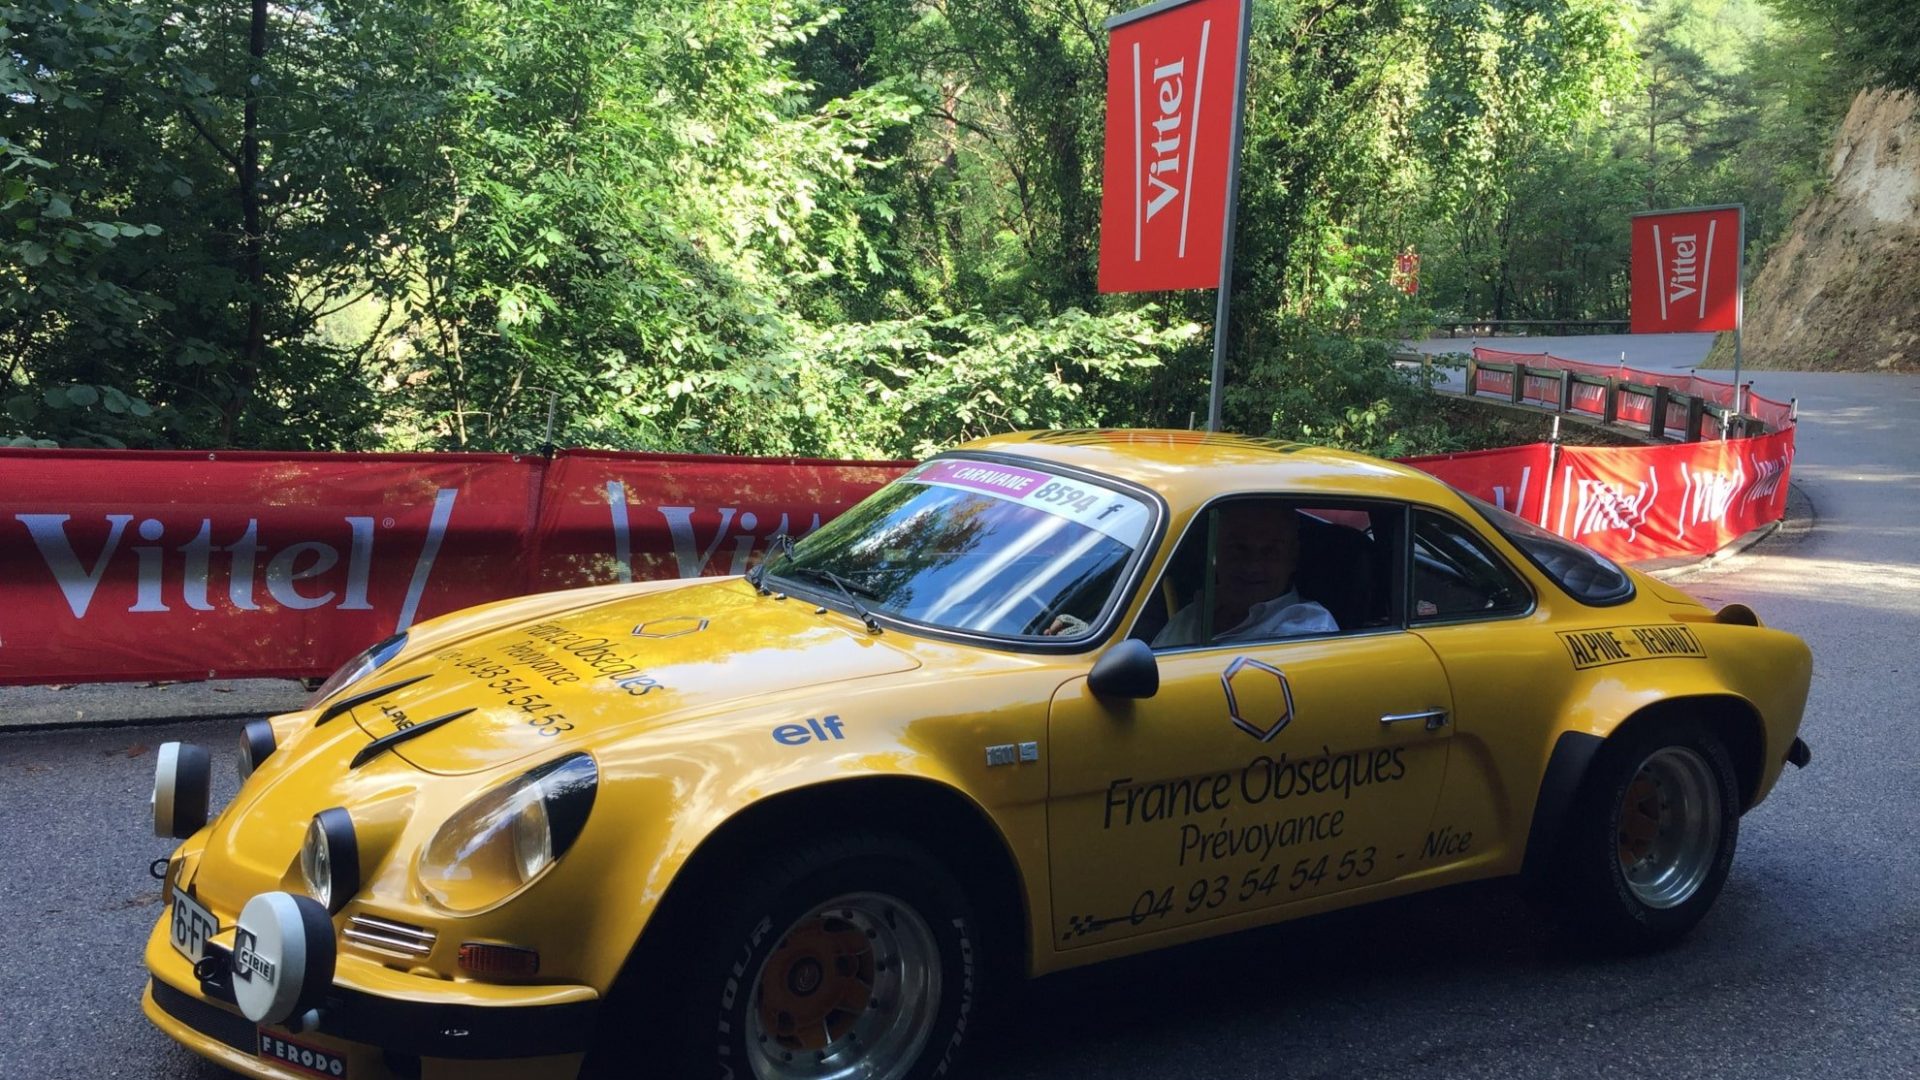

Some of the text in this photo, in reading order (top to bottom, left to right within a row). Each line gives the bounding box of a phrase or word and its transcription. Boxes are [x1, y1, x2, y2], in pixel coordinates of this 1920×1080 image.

[1147, 57, 1184, 223] Vittel
[1670, 234, 1697, 303] Vittel
[952, 466, 1035, 492] CARAVANE
[1033, 483, 1100, 514] 8594
[1565, 626, 1701, 665] ALPINE RENAULT
[470, 665, 510, 679] 93
[488, 678, 531, 695] 54
[507, 694, 553, 713] 54
[529, 714, 575, 737] 53
[772, 715, 844, 746] elf
[1104, 744, 1407, 830] France Obsèques
[1179, 809, 1345, 867] Prévoyance
[1131, 886, 1175, 926] 04
[1185, 875, 1229, 914] 93
[1239, 864, 1280, 902] 54
[1289, 854, 1329, 892] 54
[1336, 846, 1378, 882] 53
[1419, 826, 1473, 861] Nice
[262, 1035, 343, 1075] FERODO
